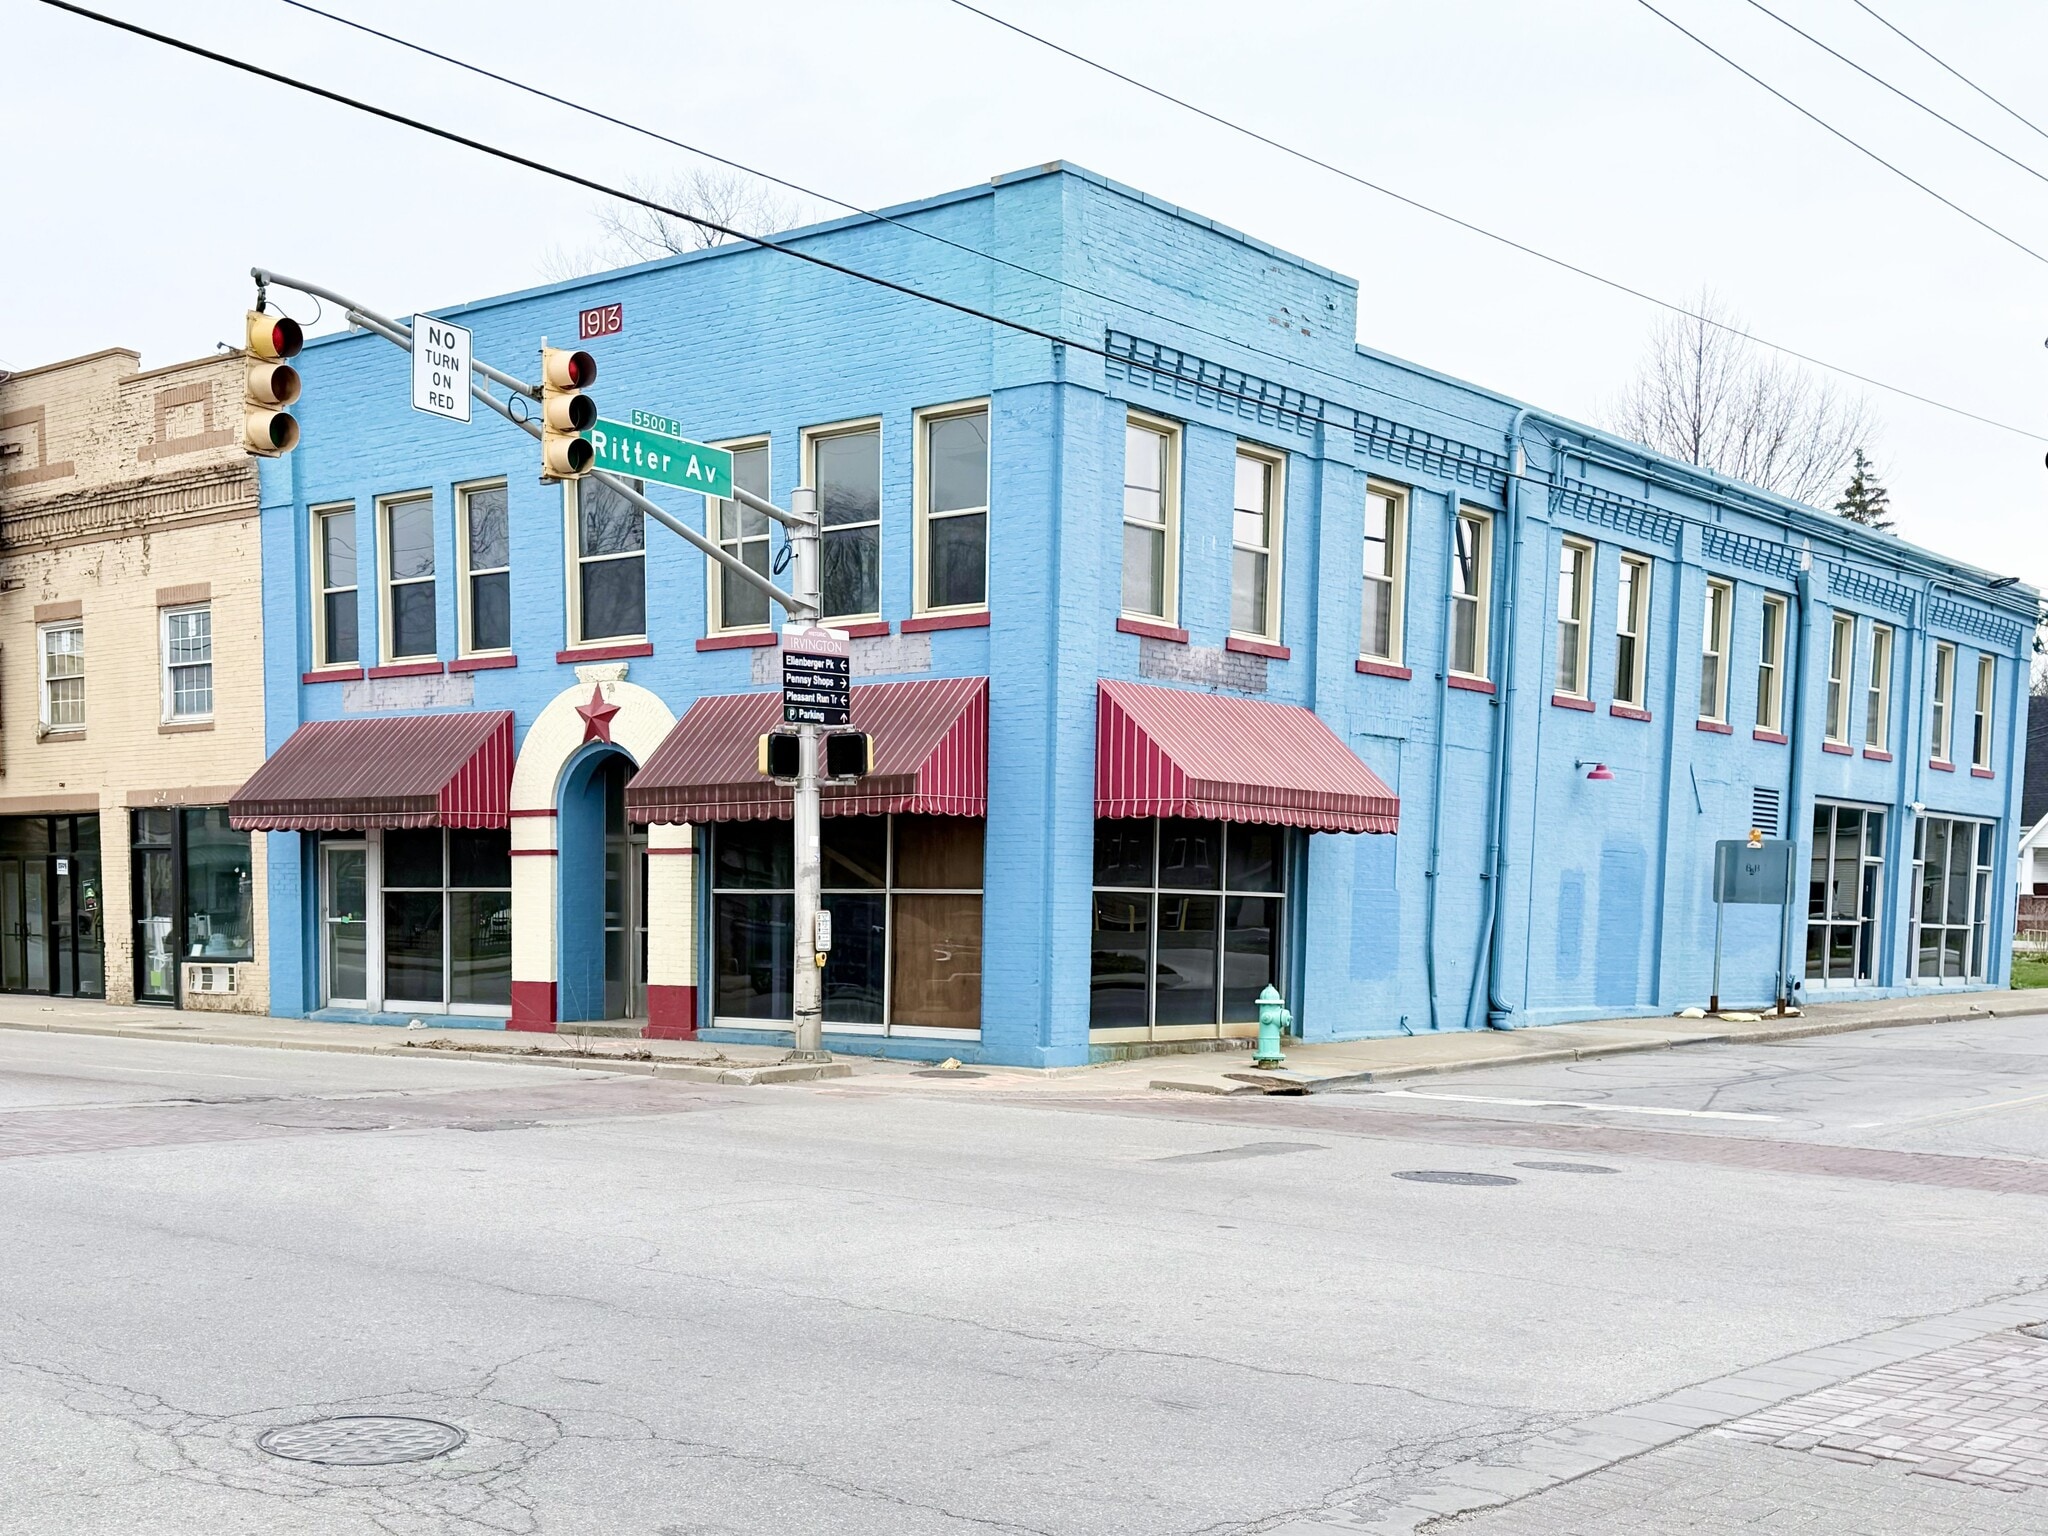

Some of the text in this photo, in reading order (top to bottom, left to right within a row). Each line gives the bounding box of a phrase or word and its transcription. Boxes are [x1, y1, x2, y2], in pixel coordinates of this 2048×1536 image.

[581, 305, 621, 337] 1913
[429, 326, 456, 349] NO
[425, 349, 460, 372] TURN
[432, 372, 452, 390] ON
[429, 391, 454, 410] RED
[634, 411, 678, 436] 5500 E
[591, 429, 717, 484] Ritter Av
[790, 638, 842, 653] IRVINGTON
[787, 655, 834, 670] Ellenberger Pk
[787, 672, 834, 688] Pennsy Shops
[787, 691, 838, 704] Pleasant Run Tr
[798, 708, 825, 723] Parking
